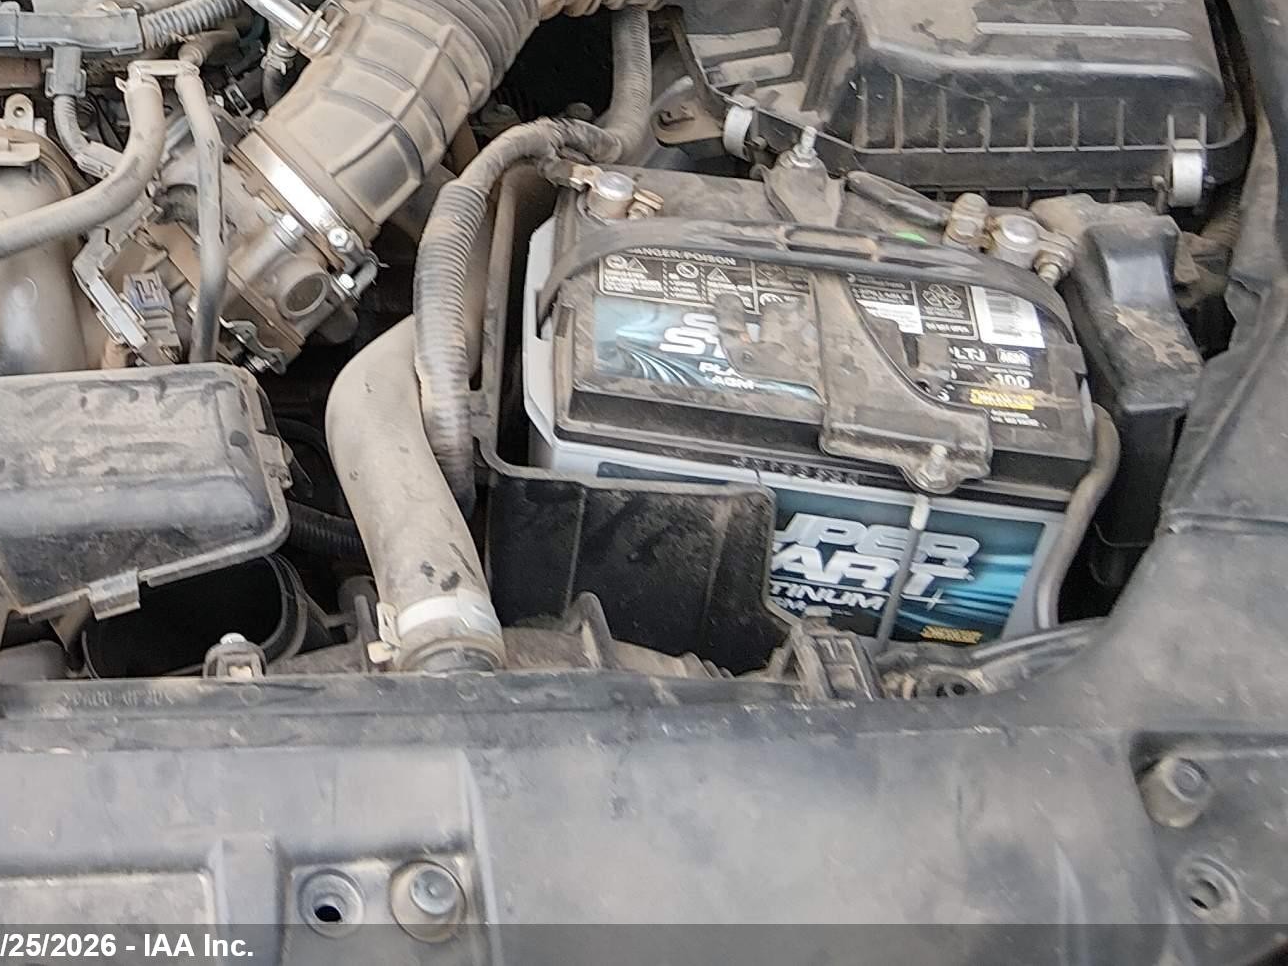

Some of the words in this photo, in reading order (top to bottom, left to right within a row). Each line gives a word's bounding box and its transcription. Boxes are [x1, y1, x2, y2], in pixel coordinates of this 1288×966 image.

[994, 373, 1031, 389] 100
[773, 512, 980, 567] UPER
[771, 543, 976, 596] ART
[770, 580, 889, 611] TINUM
